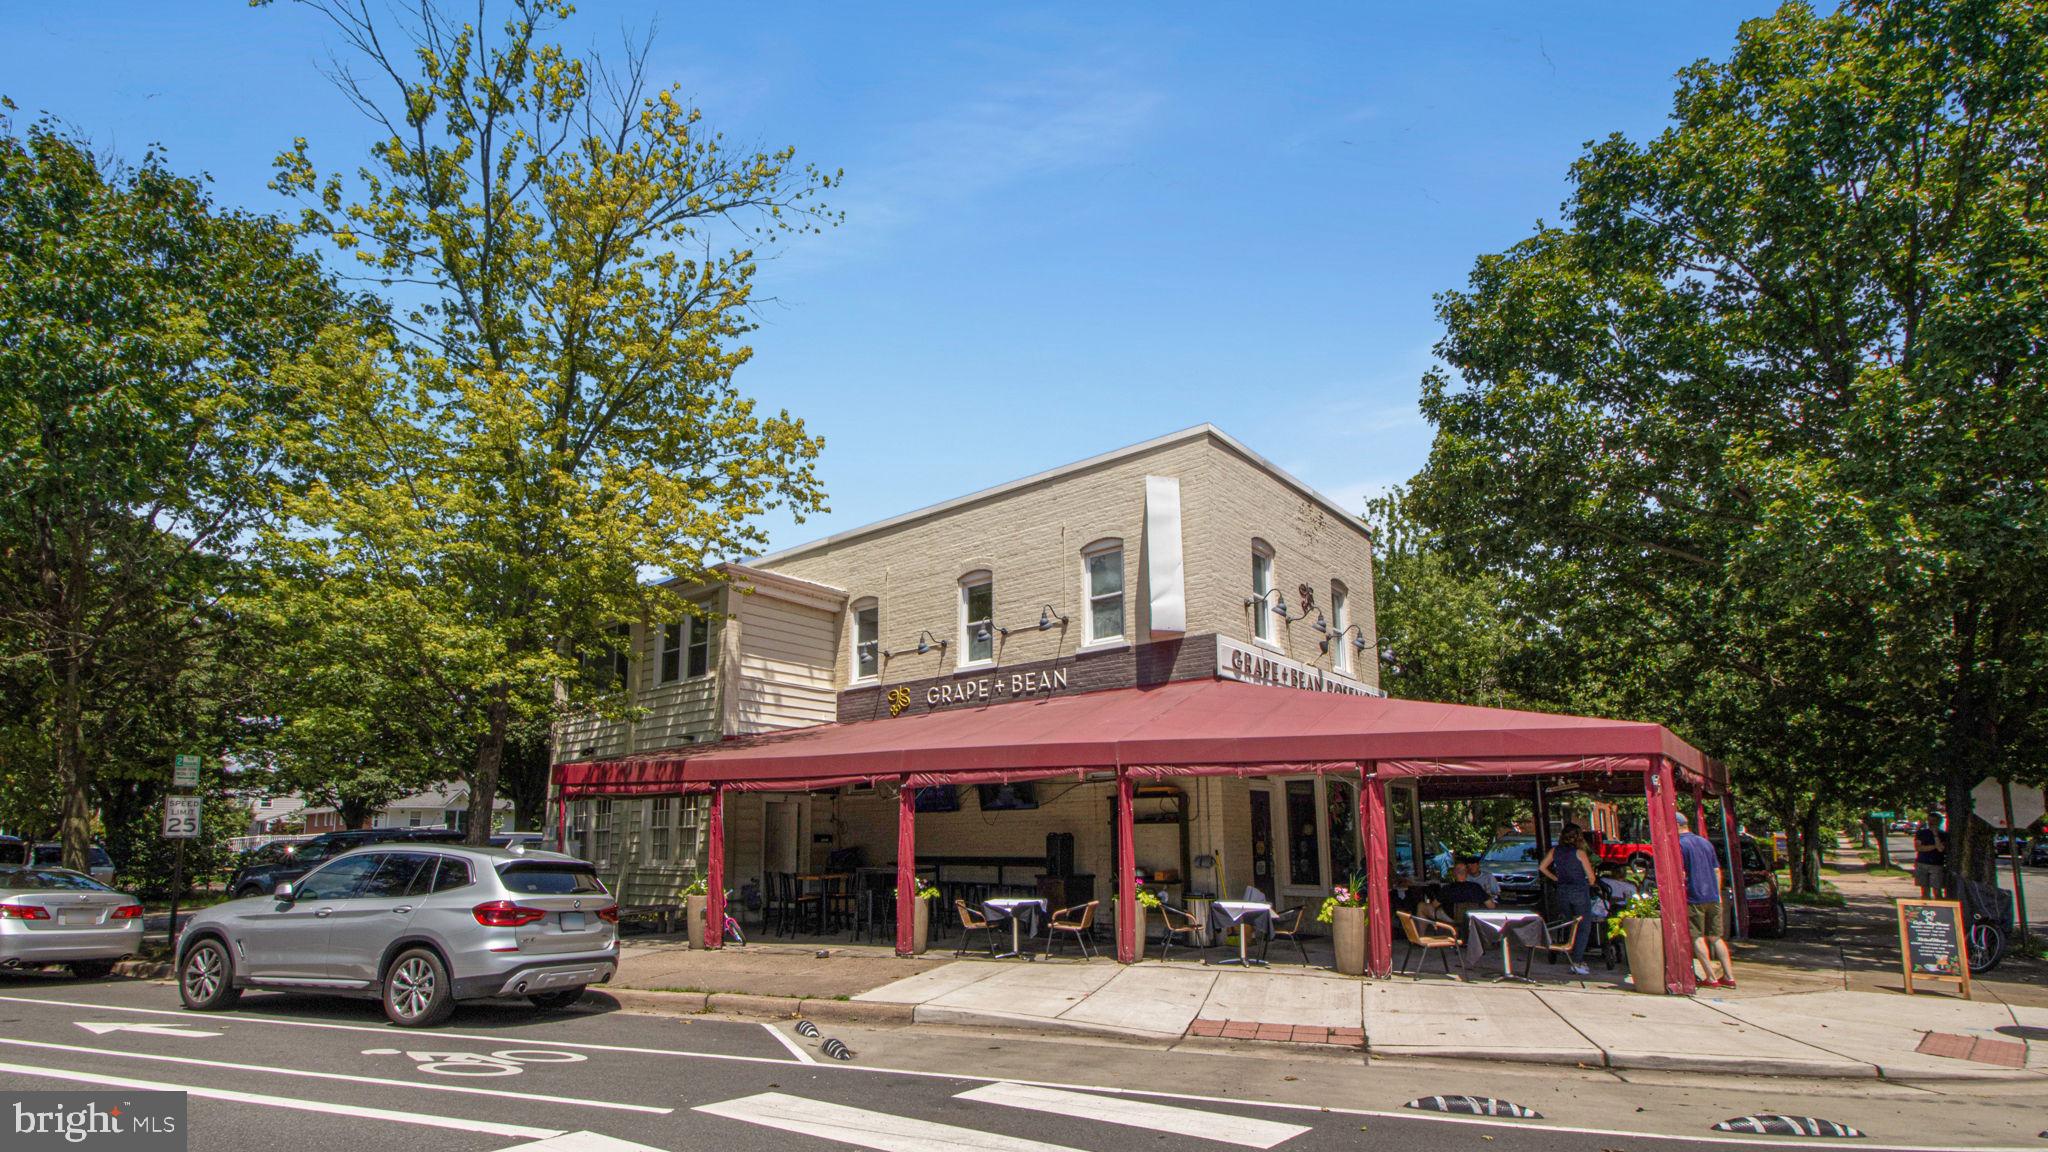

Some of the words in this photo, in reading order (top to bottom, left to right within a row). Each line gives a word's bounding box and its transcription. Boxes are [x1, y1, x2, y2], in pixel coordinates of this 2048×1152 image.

[927, 679, 989, 704] GRAPE
[994, 679, 1005, 694] +
[1011, 667, 1068, 694] BEAN
[1231, 649, 1279, 682] GRAPE
[1290, 667, 1322, 693] BEAN
[167, 817, 196, 832] 25
